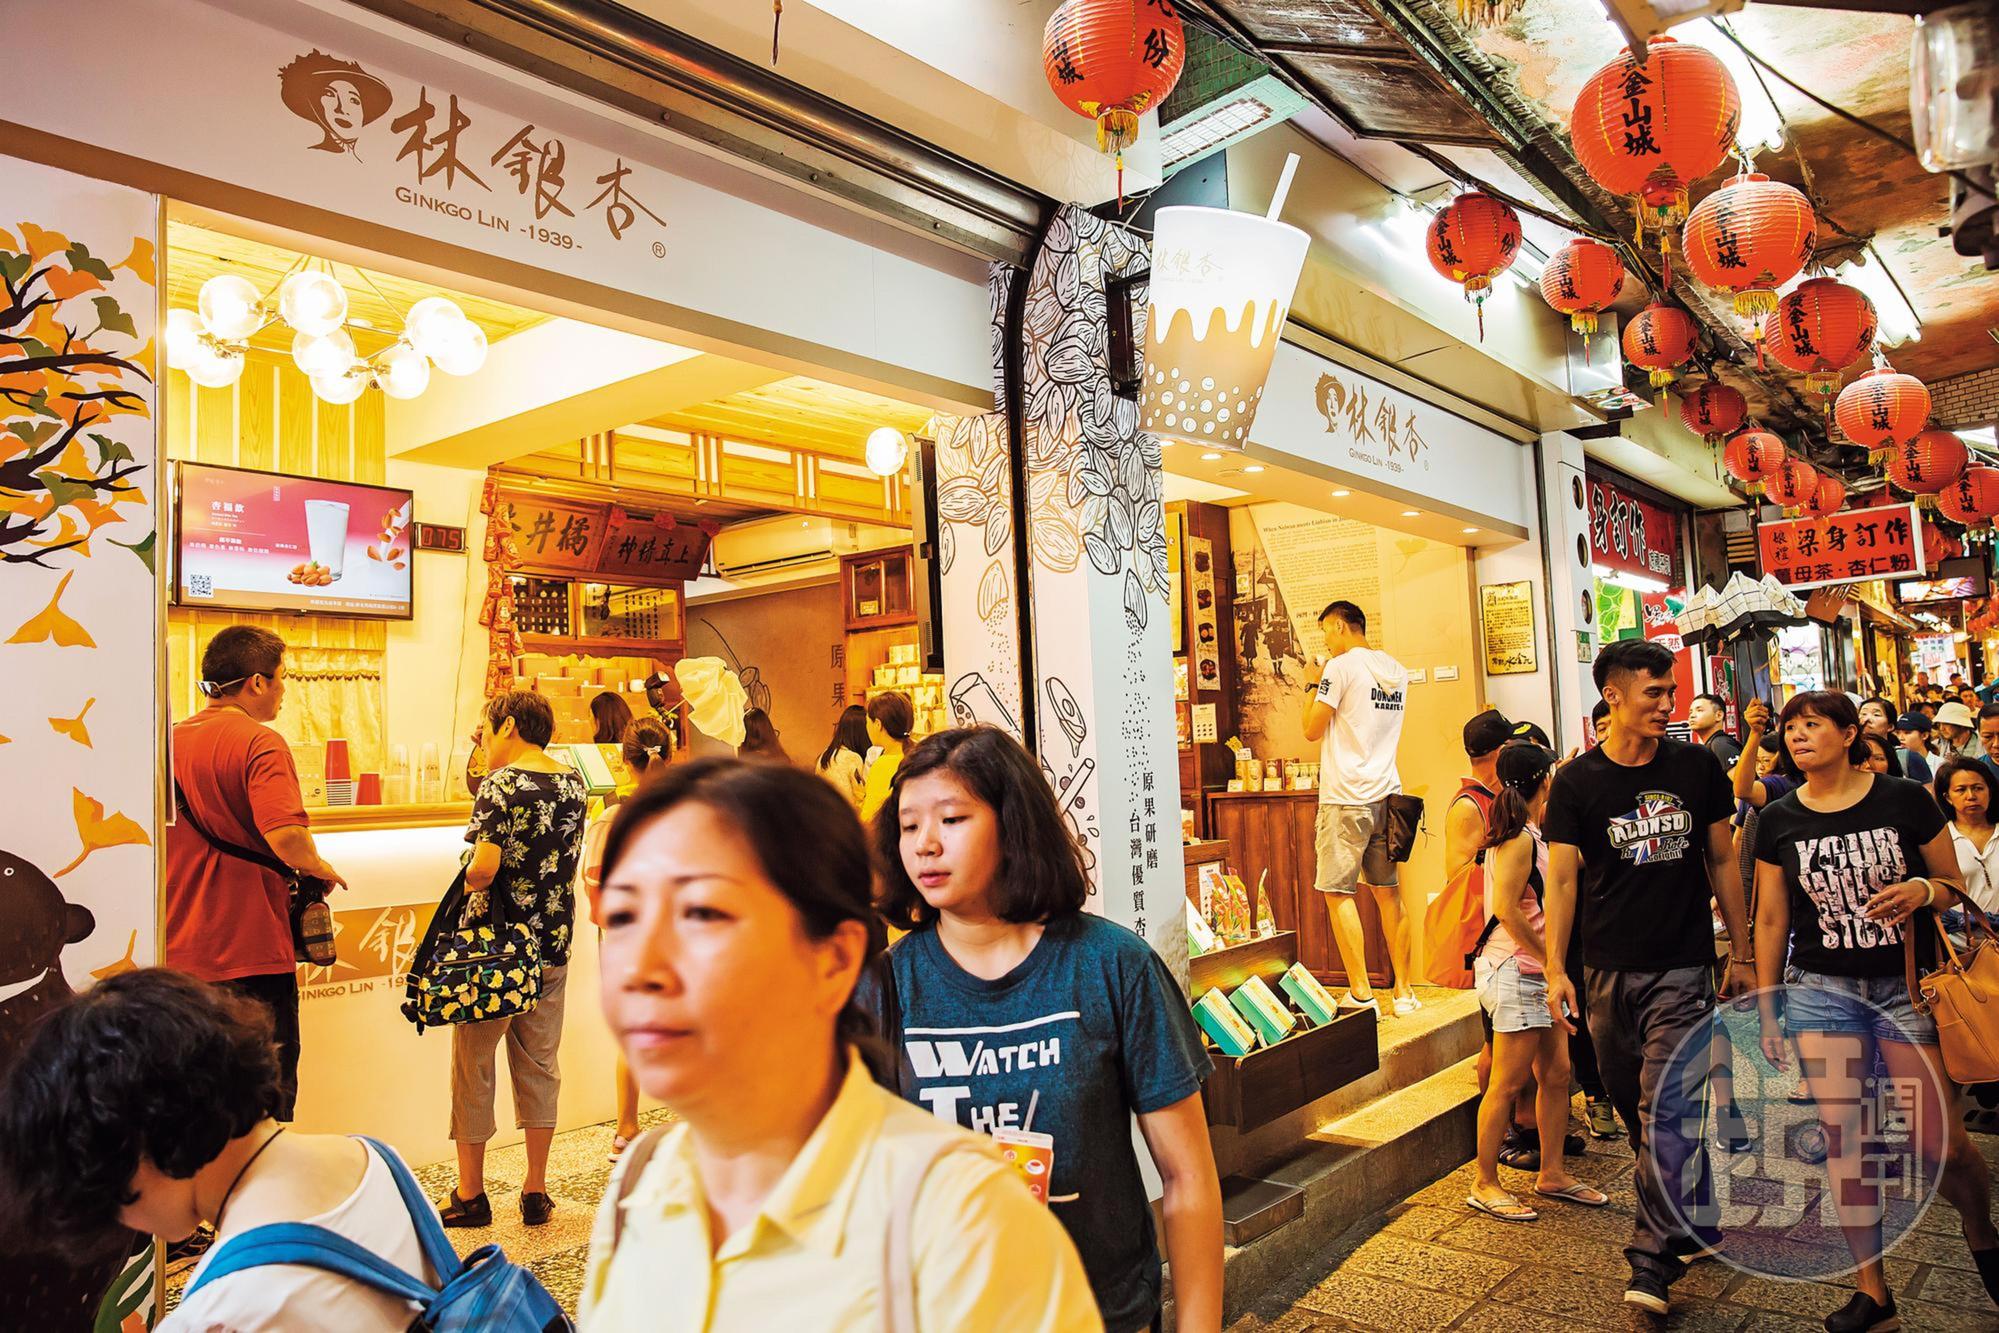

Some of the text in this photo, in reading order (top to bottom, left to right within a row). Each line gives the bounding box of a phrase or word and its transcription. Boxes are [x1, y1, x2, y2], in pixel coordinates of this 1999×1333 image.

[390, 86, 668, 241] 林銀杏
[394, 185, 473, 222] GINKGO
[477, 208, 510, 233] LIN
[1345, 383, 1429, 463] 林銀杏
[1590, 483, 1647, 567] 身訂作
[1142, 771, 1158, 870] 原果研磨
[1612, 812, 1685, 844] ALONSO
[1795, 826, 1907, 876] YOUR
[298, 986, 346, 1001] INKGO
[350, 982, 374, 994] LIN
[905, 1037, 1060, 1078] WATCH
